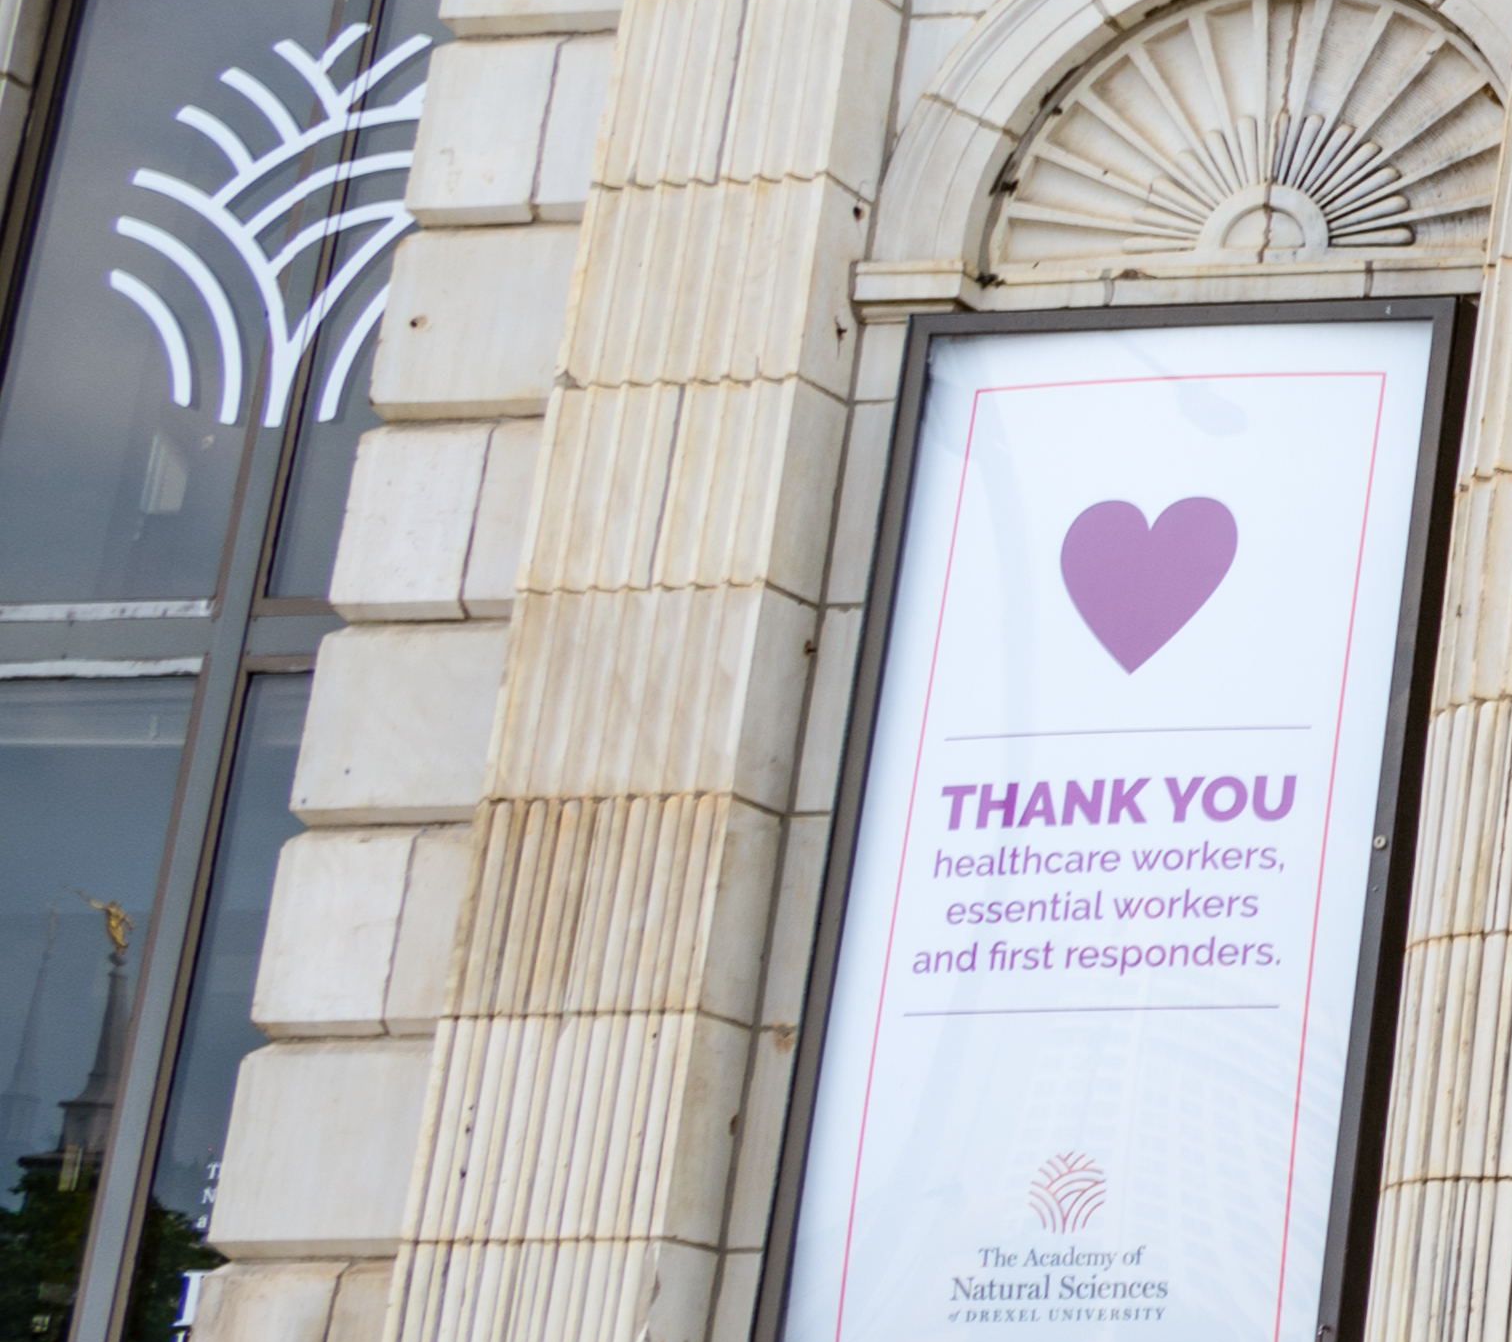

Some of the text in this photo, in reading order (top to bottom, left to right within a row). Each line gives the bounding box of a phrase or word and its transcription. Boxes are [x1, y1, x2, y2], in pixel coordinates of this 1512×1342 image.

[941, 774, 1297, 831] THANK YOU
[933, 840, 1285, 879] healthcare workers,
[946, 888, 1259, 925] essential workers
[912, 936, 1282, 976] and first responders.
[978, 1244, 1146, 1271] The Academy of
[950, 1273, 1168, 1301] Natural Sciences
[948, 1306, 1166, 1323] of DREXEL UNIVERSITY
